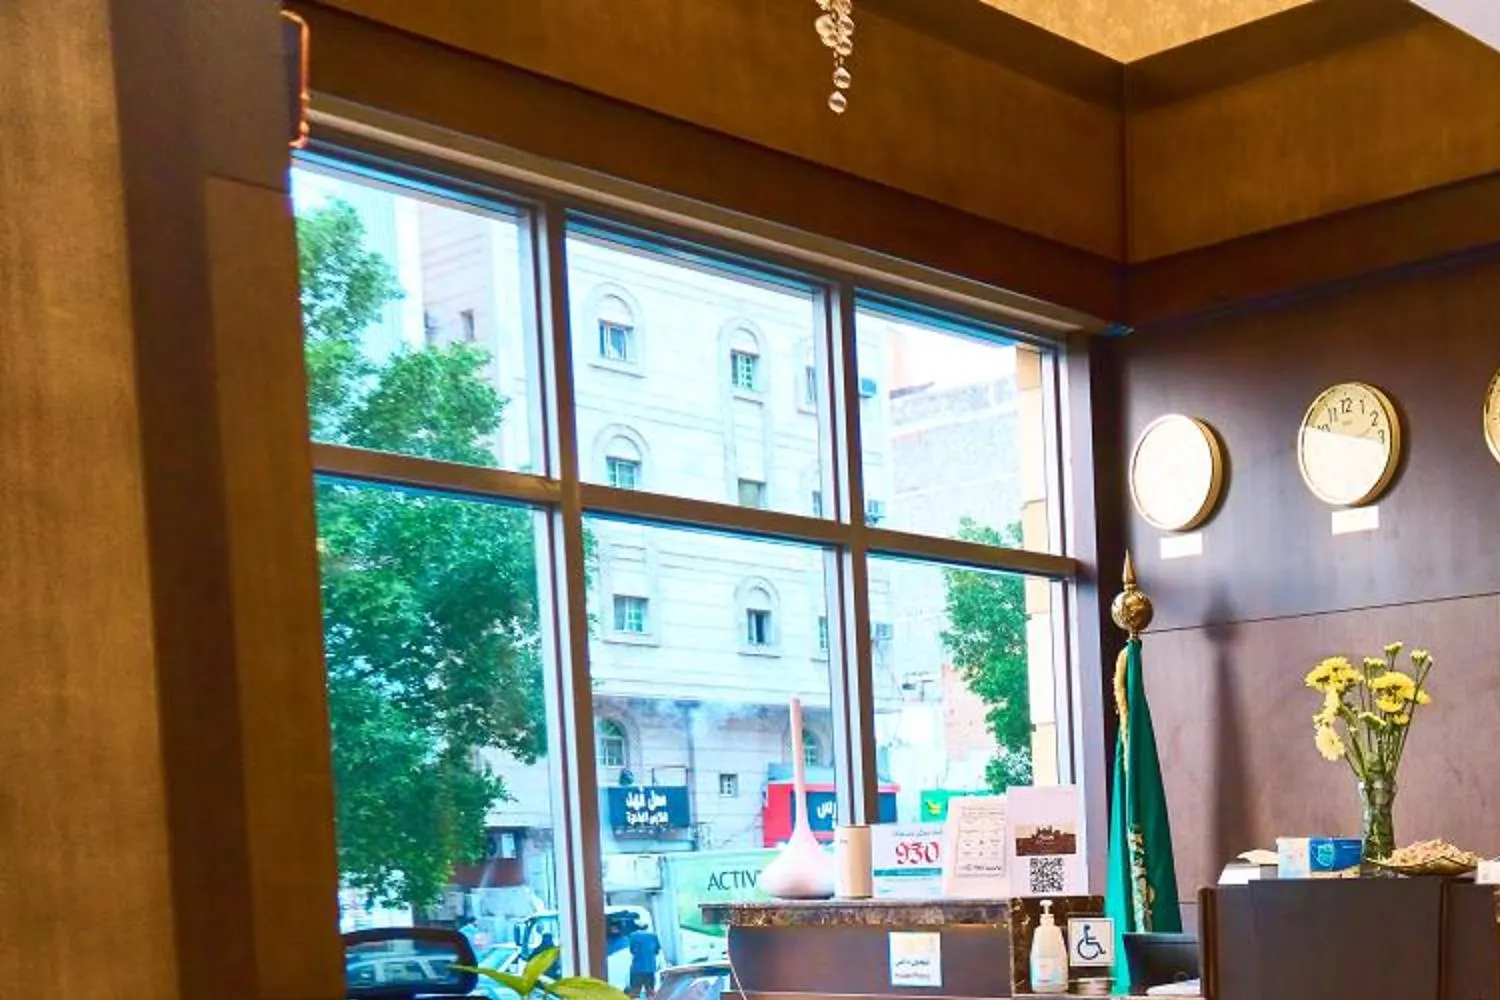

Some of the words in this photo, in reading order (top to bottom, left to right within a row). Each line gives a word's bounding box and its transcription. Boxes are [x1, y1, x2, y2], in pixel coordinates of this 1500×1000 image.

[1340, 397, 1353, 414] 12
[1328, 407, 1338, 424] 11
[1370, 410, 1379, 427] 2
[895, 841, 940, 865] 930
